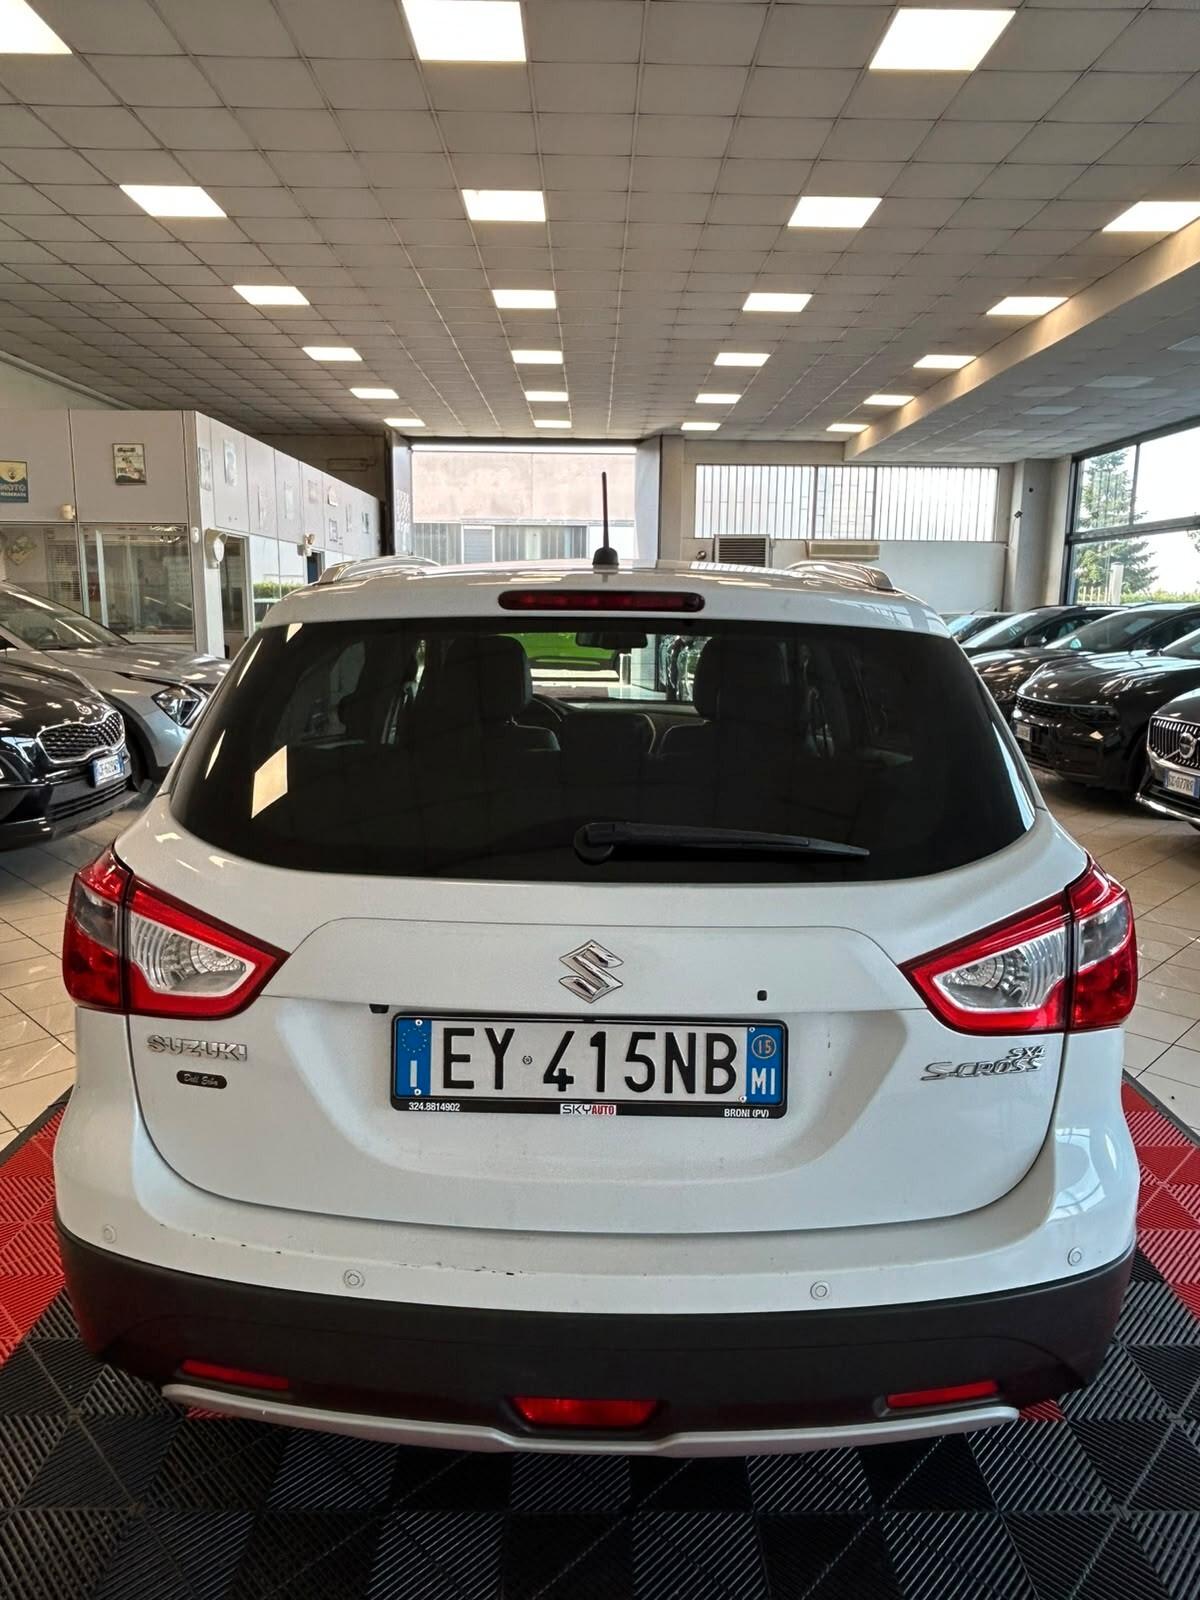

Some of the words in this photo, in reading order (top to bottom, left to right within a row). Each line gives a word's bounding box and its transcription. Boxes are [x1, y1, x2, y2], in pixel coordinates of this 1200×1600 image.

[147, 1034, 248, 1062] SUZUKI
[757, 1039, 772, 1054] 15
[409, 1059, 418, 1088] I
[443, 1028, 516, 1090] EY
[543, 1030, 738, 1095] 415NB
[751, 1067, 776, 1096] MI
[408, 1101, 461, 1112] 324.8814902
[724, 1108, 751, 1118] BRONI
[752, 1109, 770, 1118] (PV)
